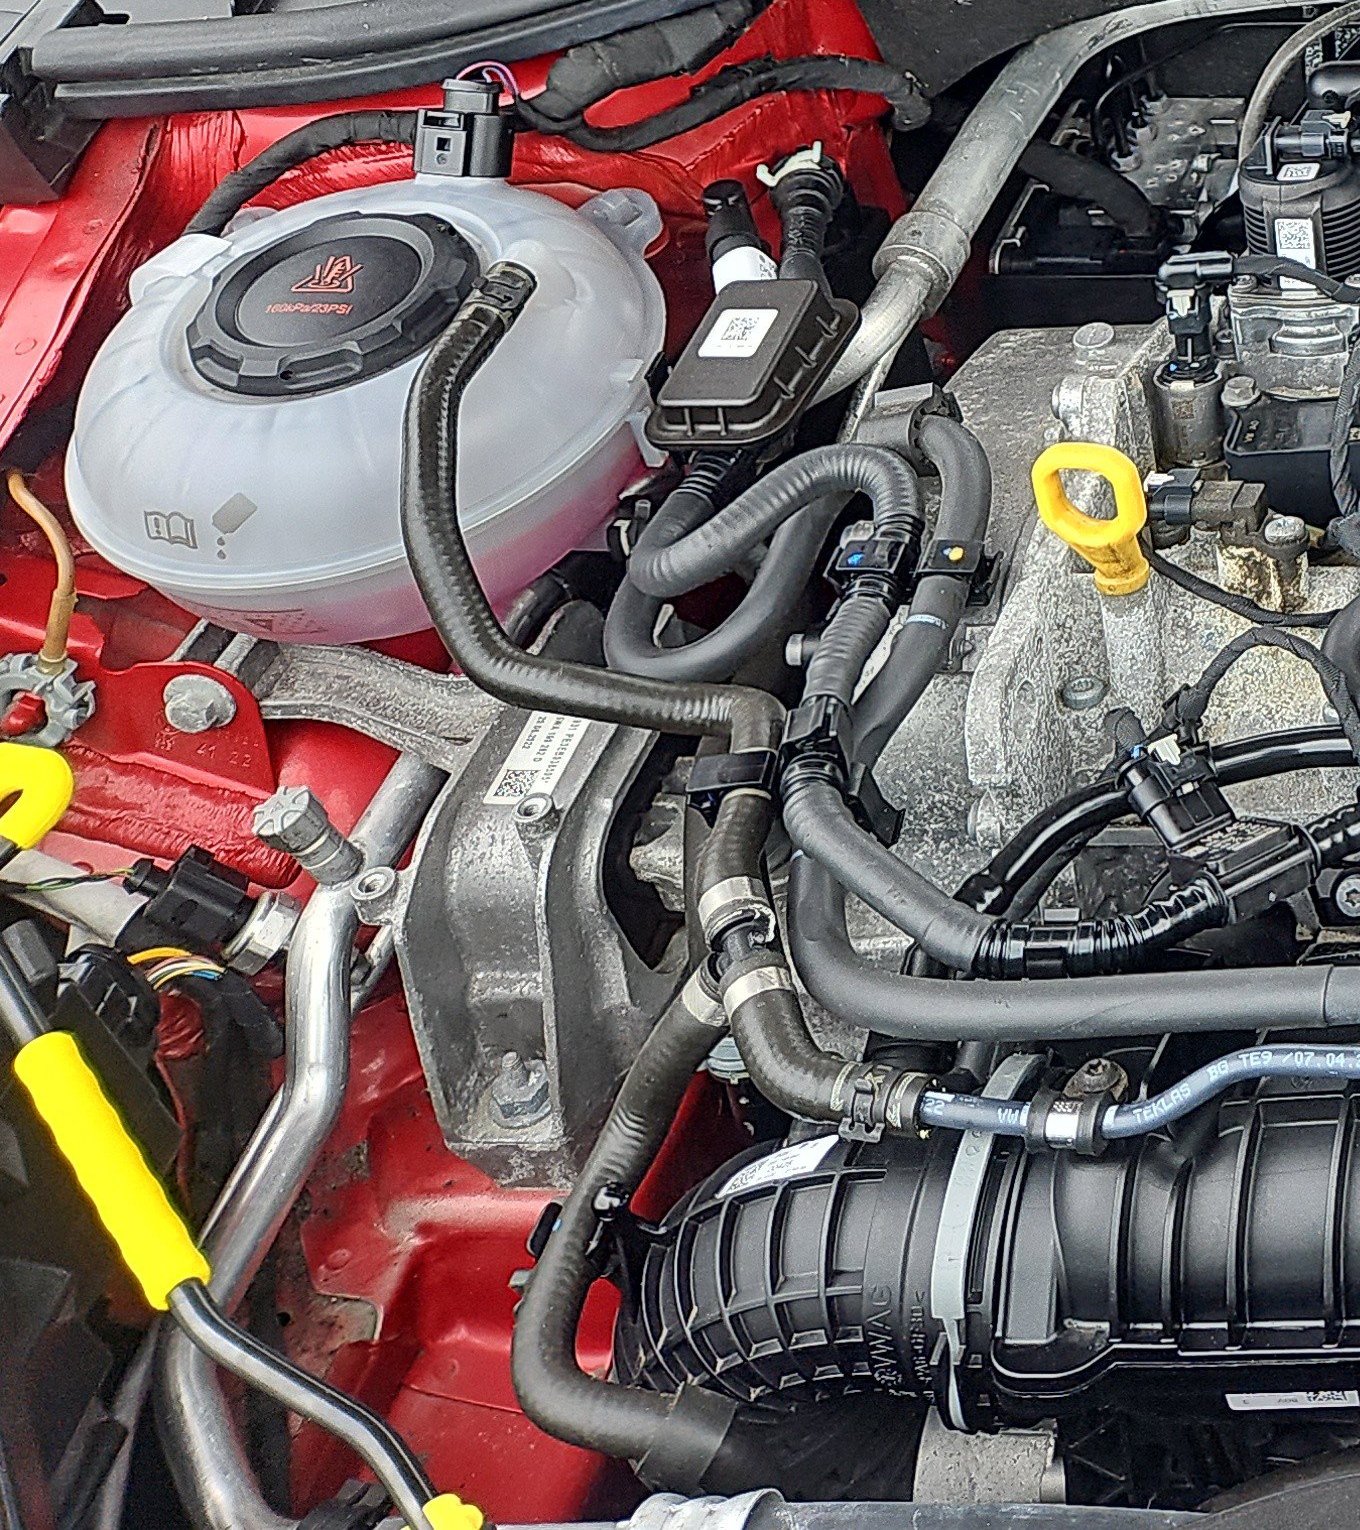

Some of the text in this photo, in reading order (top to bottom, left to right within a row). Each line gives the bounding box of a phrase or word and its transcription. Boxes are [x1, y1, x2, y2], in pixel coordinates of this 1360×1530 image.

[1132, 1083, 1192, 1124] TEKLAS
[1238, 1050, 1273, 1070] TE9
[865, 1283, 897, 1369] VWAG
